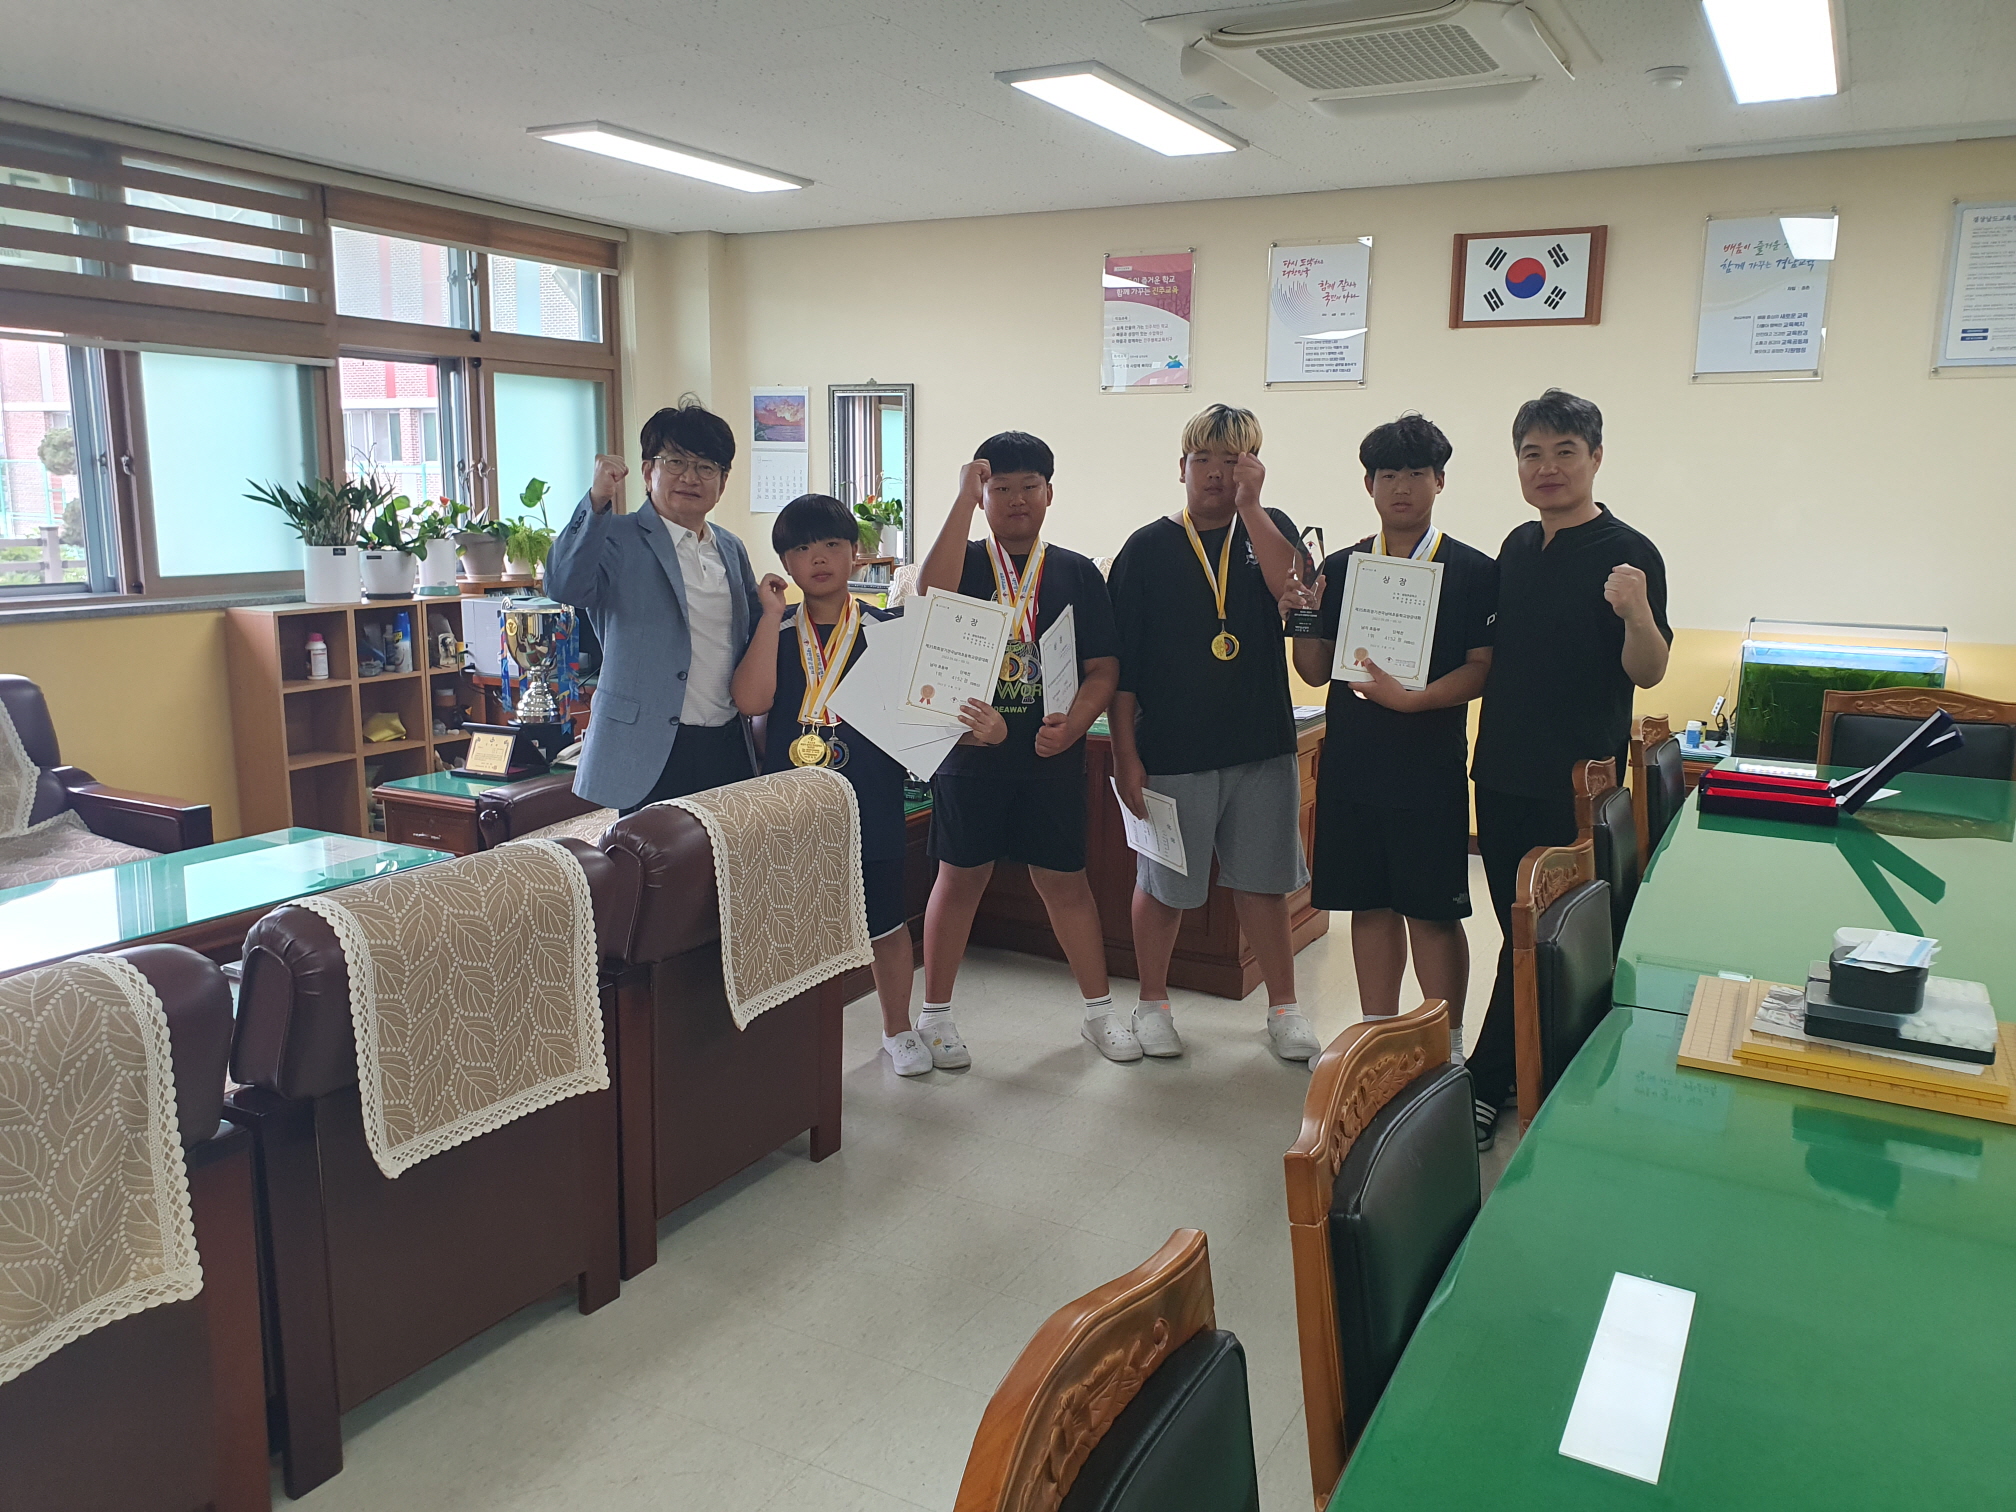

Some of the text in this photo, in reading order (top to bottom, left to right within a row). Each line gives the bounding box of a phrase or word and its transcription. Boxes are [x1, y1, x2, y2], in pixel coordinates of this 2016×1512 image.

[1724, 242, 1751, 256] 배움이
[1753, 240, 1780, 256] 즐거운
[1283, 259, 1298, 268] 다시
[1720, 258, 1746, 273] 함께
[1748, 261, 1772, 270] 가꾸는
[1282, 267, 1311, 278] 대한민국
[1142, 276, 1160, 285] 즐거운
[1162, 276, 1175, 284] 학교
[1318, 280, 1336, 291] 함께
[1116, 286, 1179, 298] 함께 가꾸는 진주교육
[1343, 291, 1360, 303] 나라
[1383, 576, 1407, 586] 상 장
[955, 615, 978, 626] 상 장
